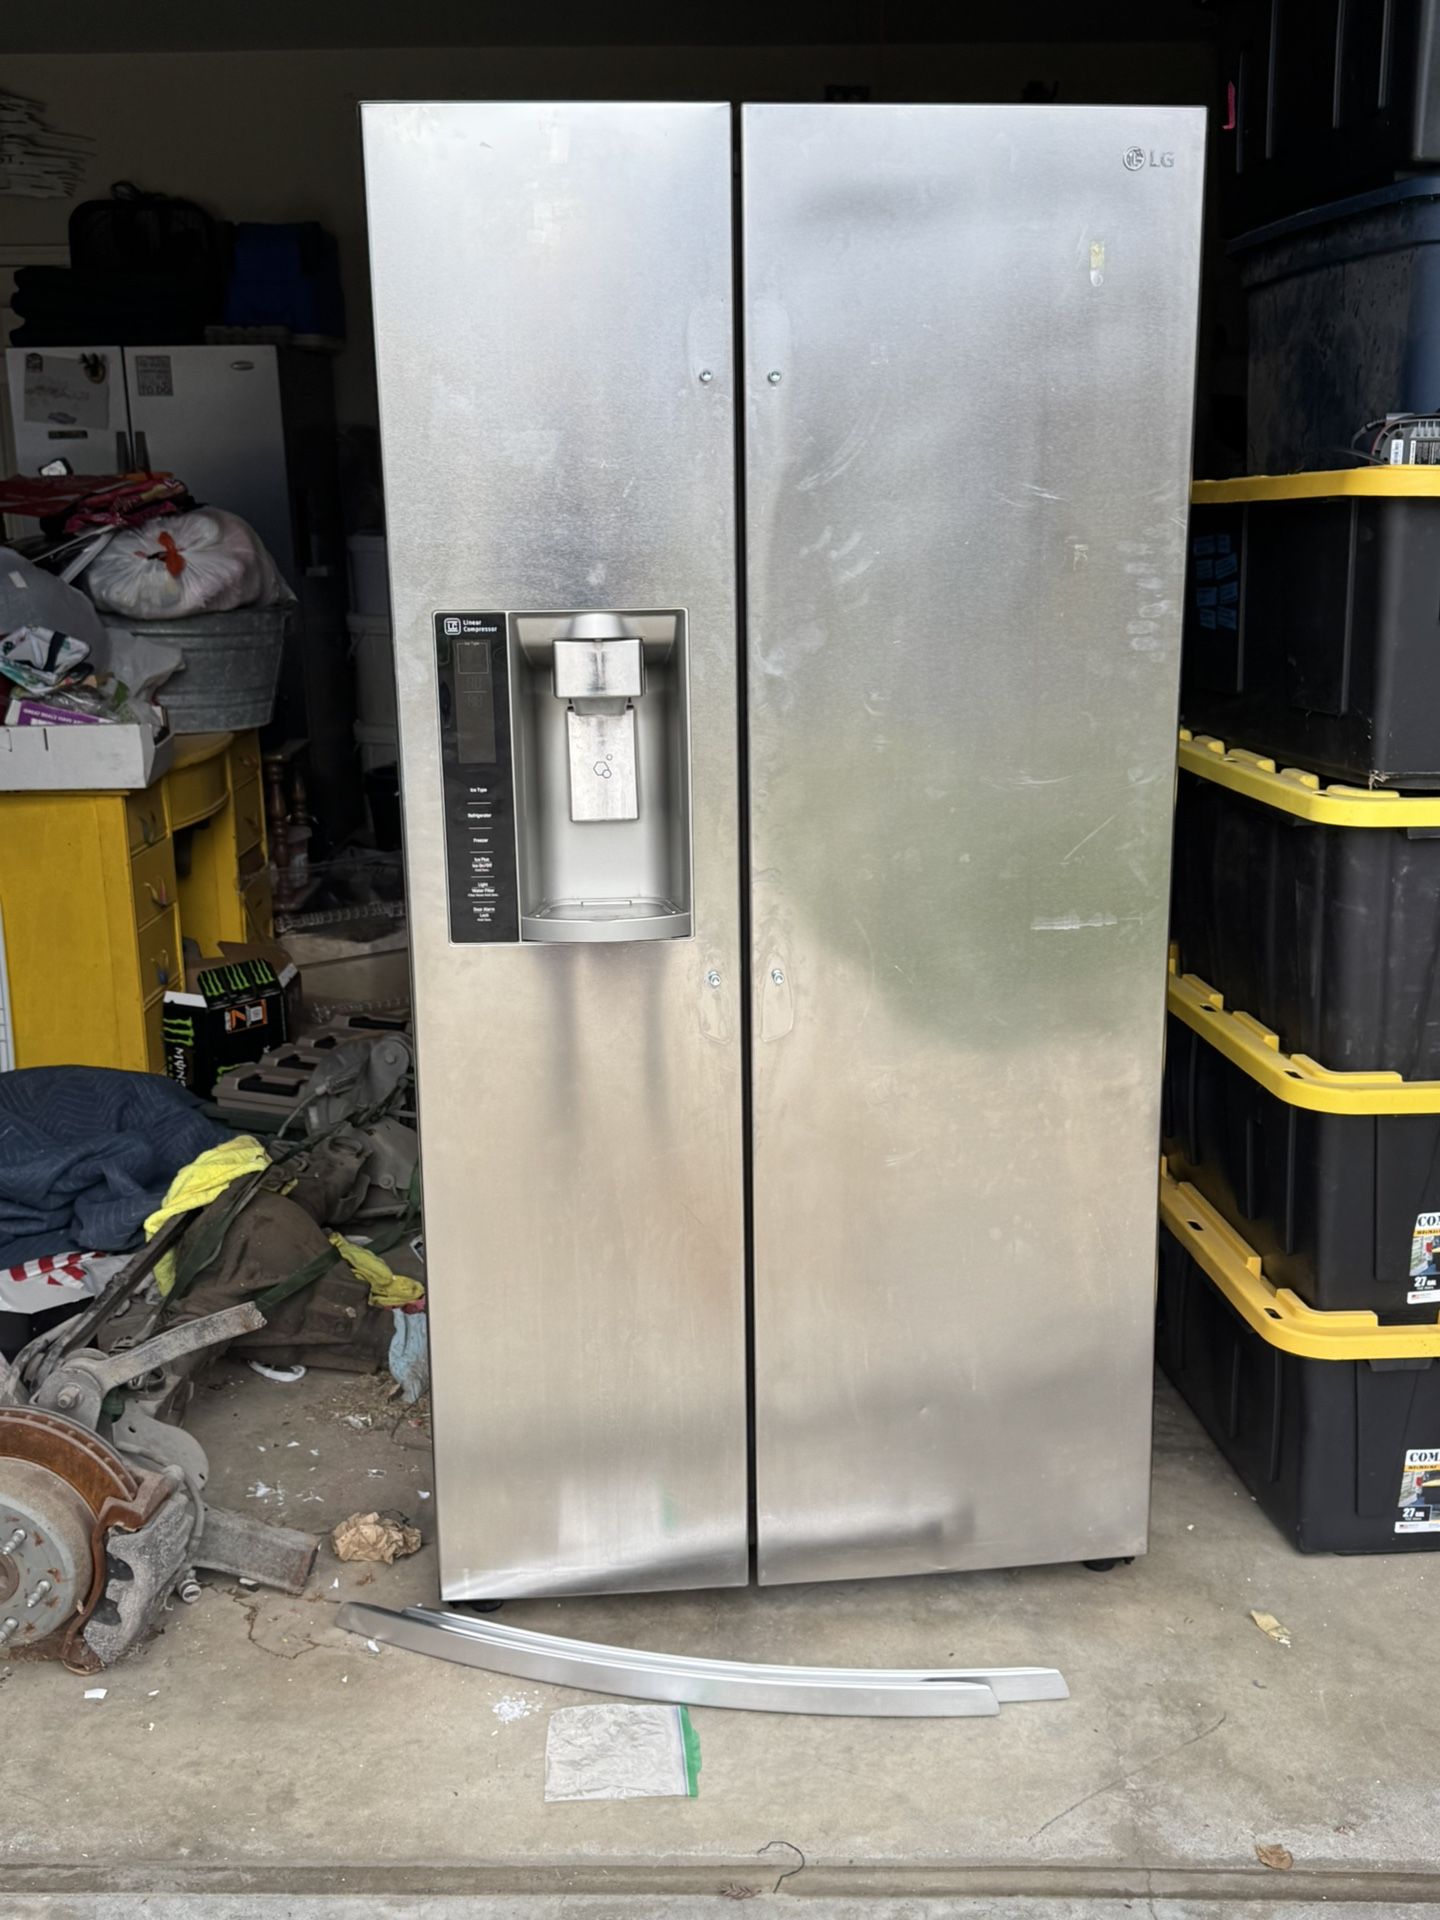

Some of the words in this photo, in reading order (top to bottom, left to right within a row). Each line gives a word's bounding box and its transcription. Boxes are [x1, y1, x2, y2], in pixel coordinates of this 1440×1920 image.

[1149, 149, 1175, 168] LG
[1414, 1275, 1427, 1287] 27
[1402, 1507, 1416, 1518] 27
